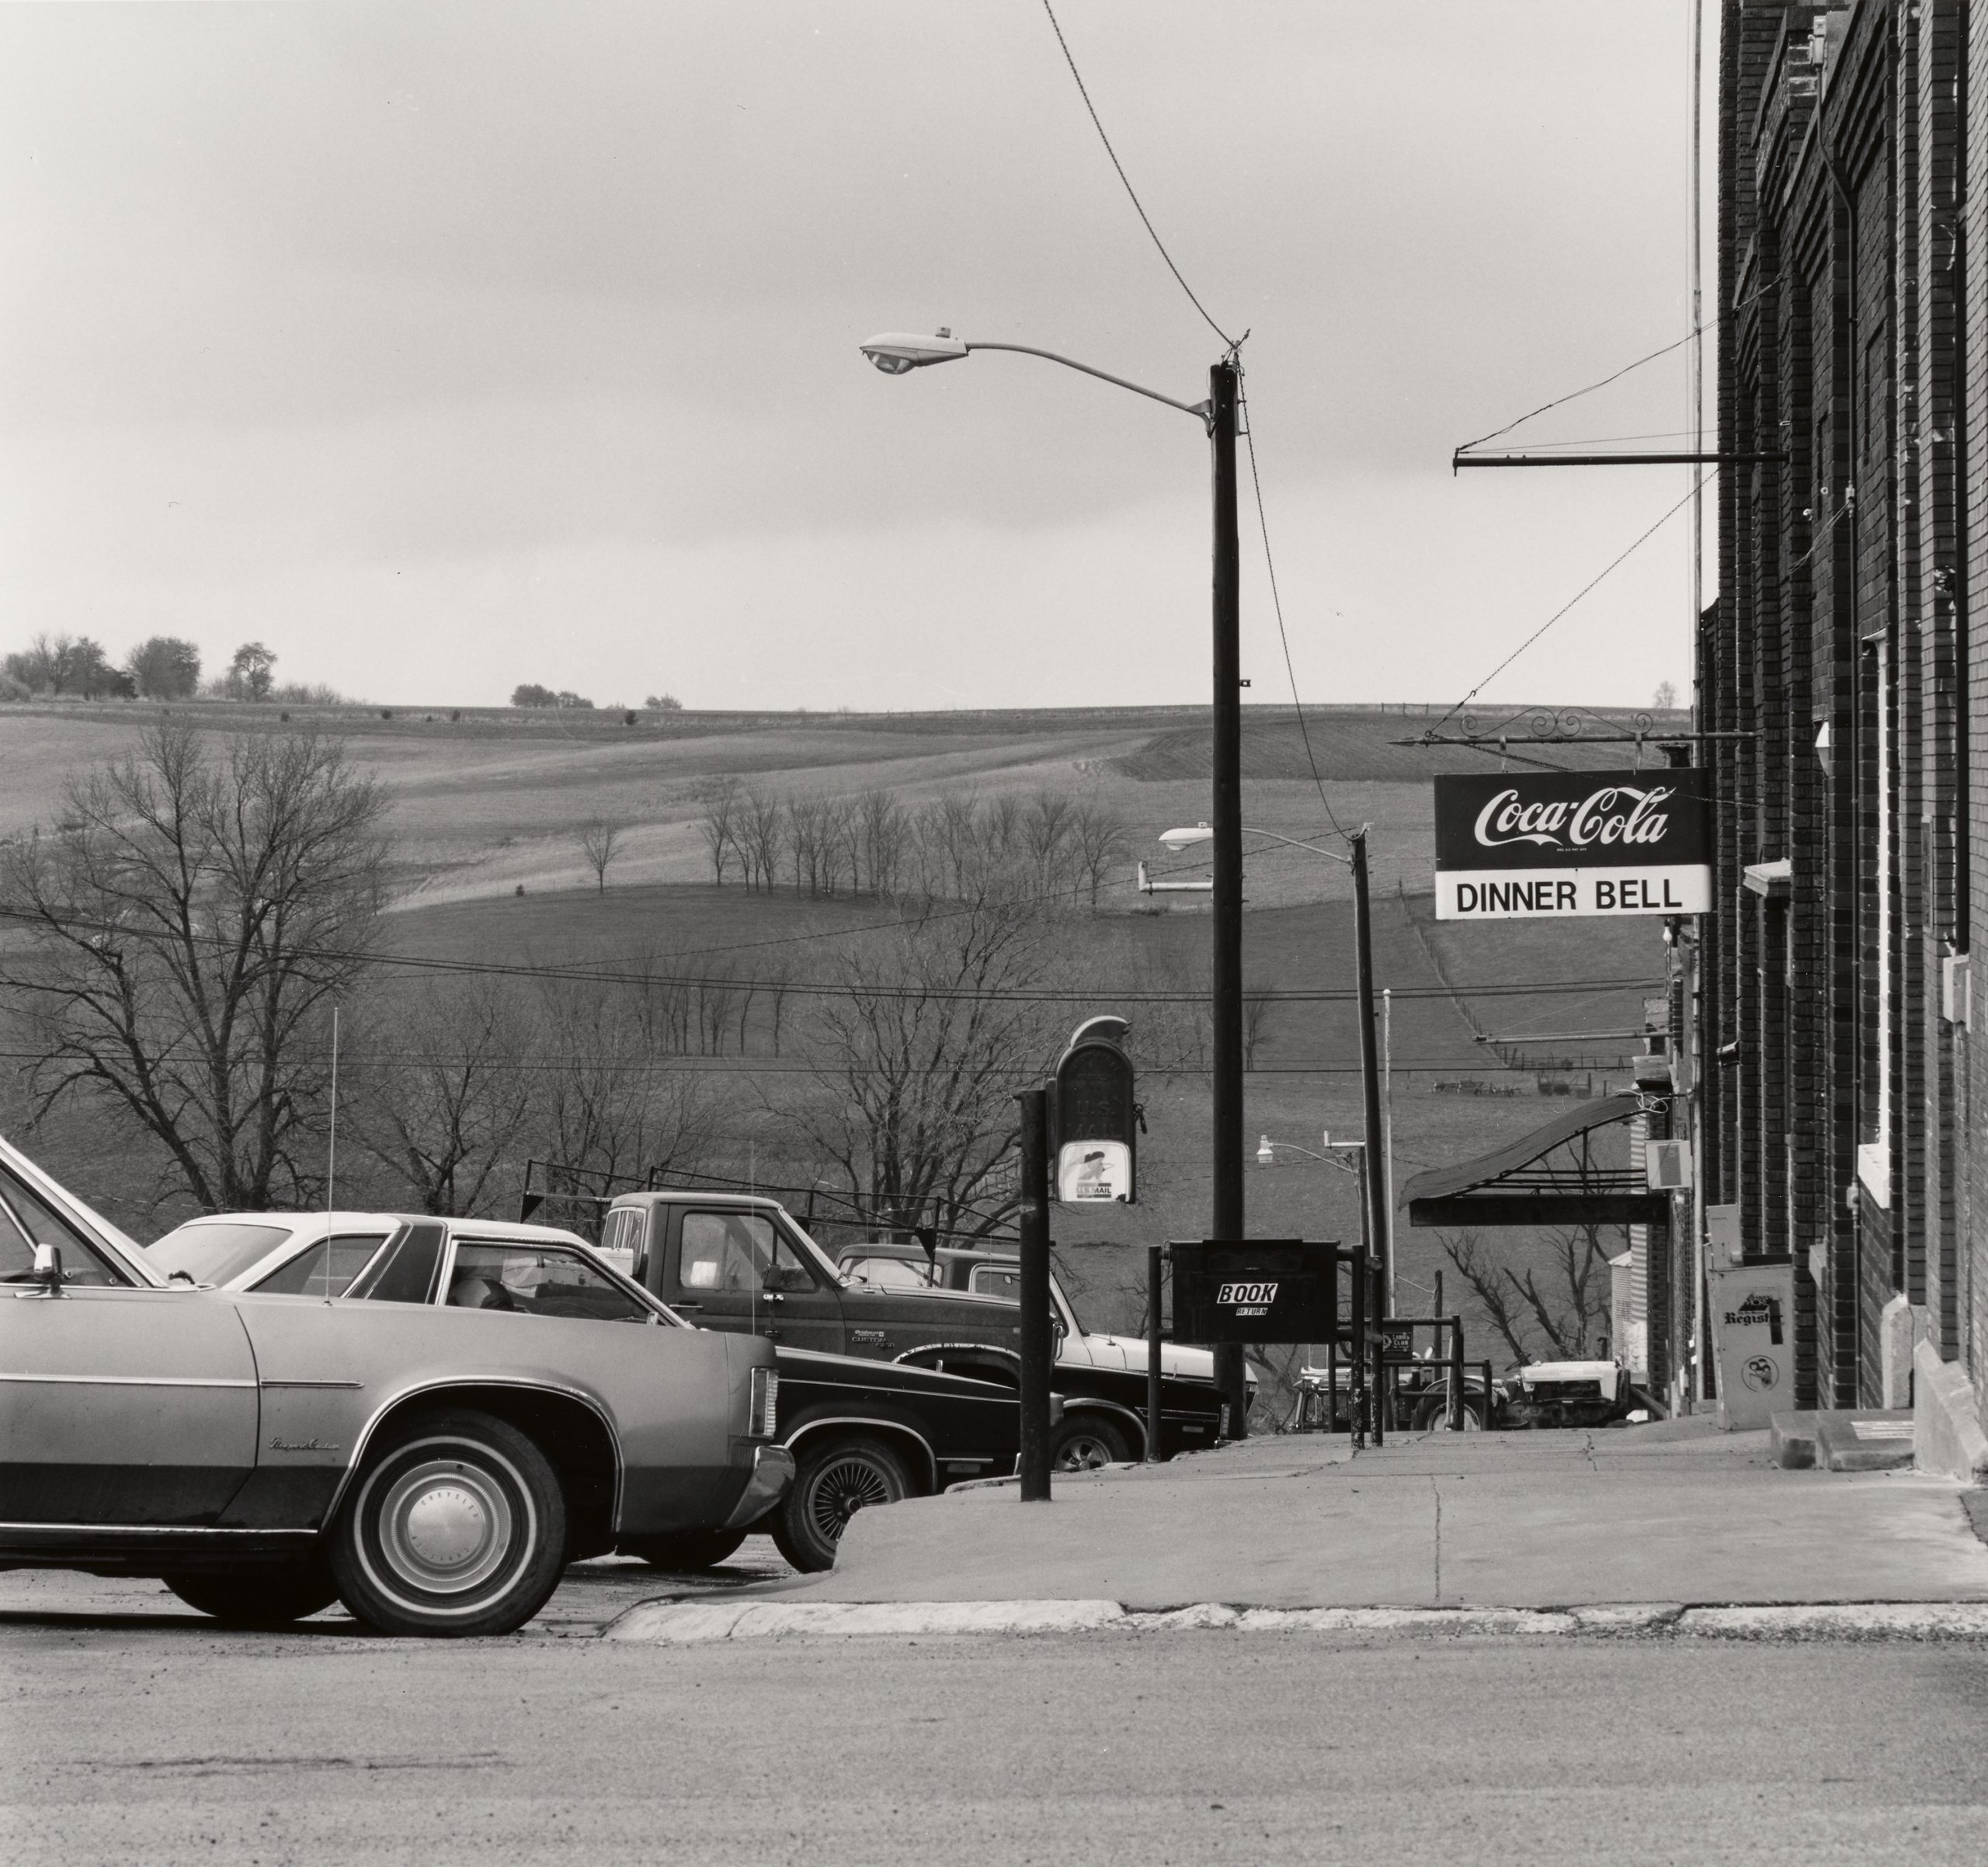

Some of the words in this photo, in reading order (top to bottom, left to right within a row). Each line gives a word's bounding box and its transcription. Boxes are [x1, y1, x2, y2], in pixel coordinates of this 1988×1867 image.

[1475, 786, 1677, 847] Coca-Cola
[1456, 881, 1576, 913] DINNER
[1595, 878, 1682, 909] BELL
[1218, 1285, 1276, 1302] BOOK
[421, 1492, 479, 1518] CHRYSLER
